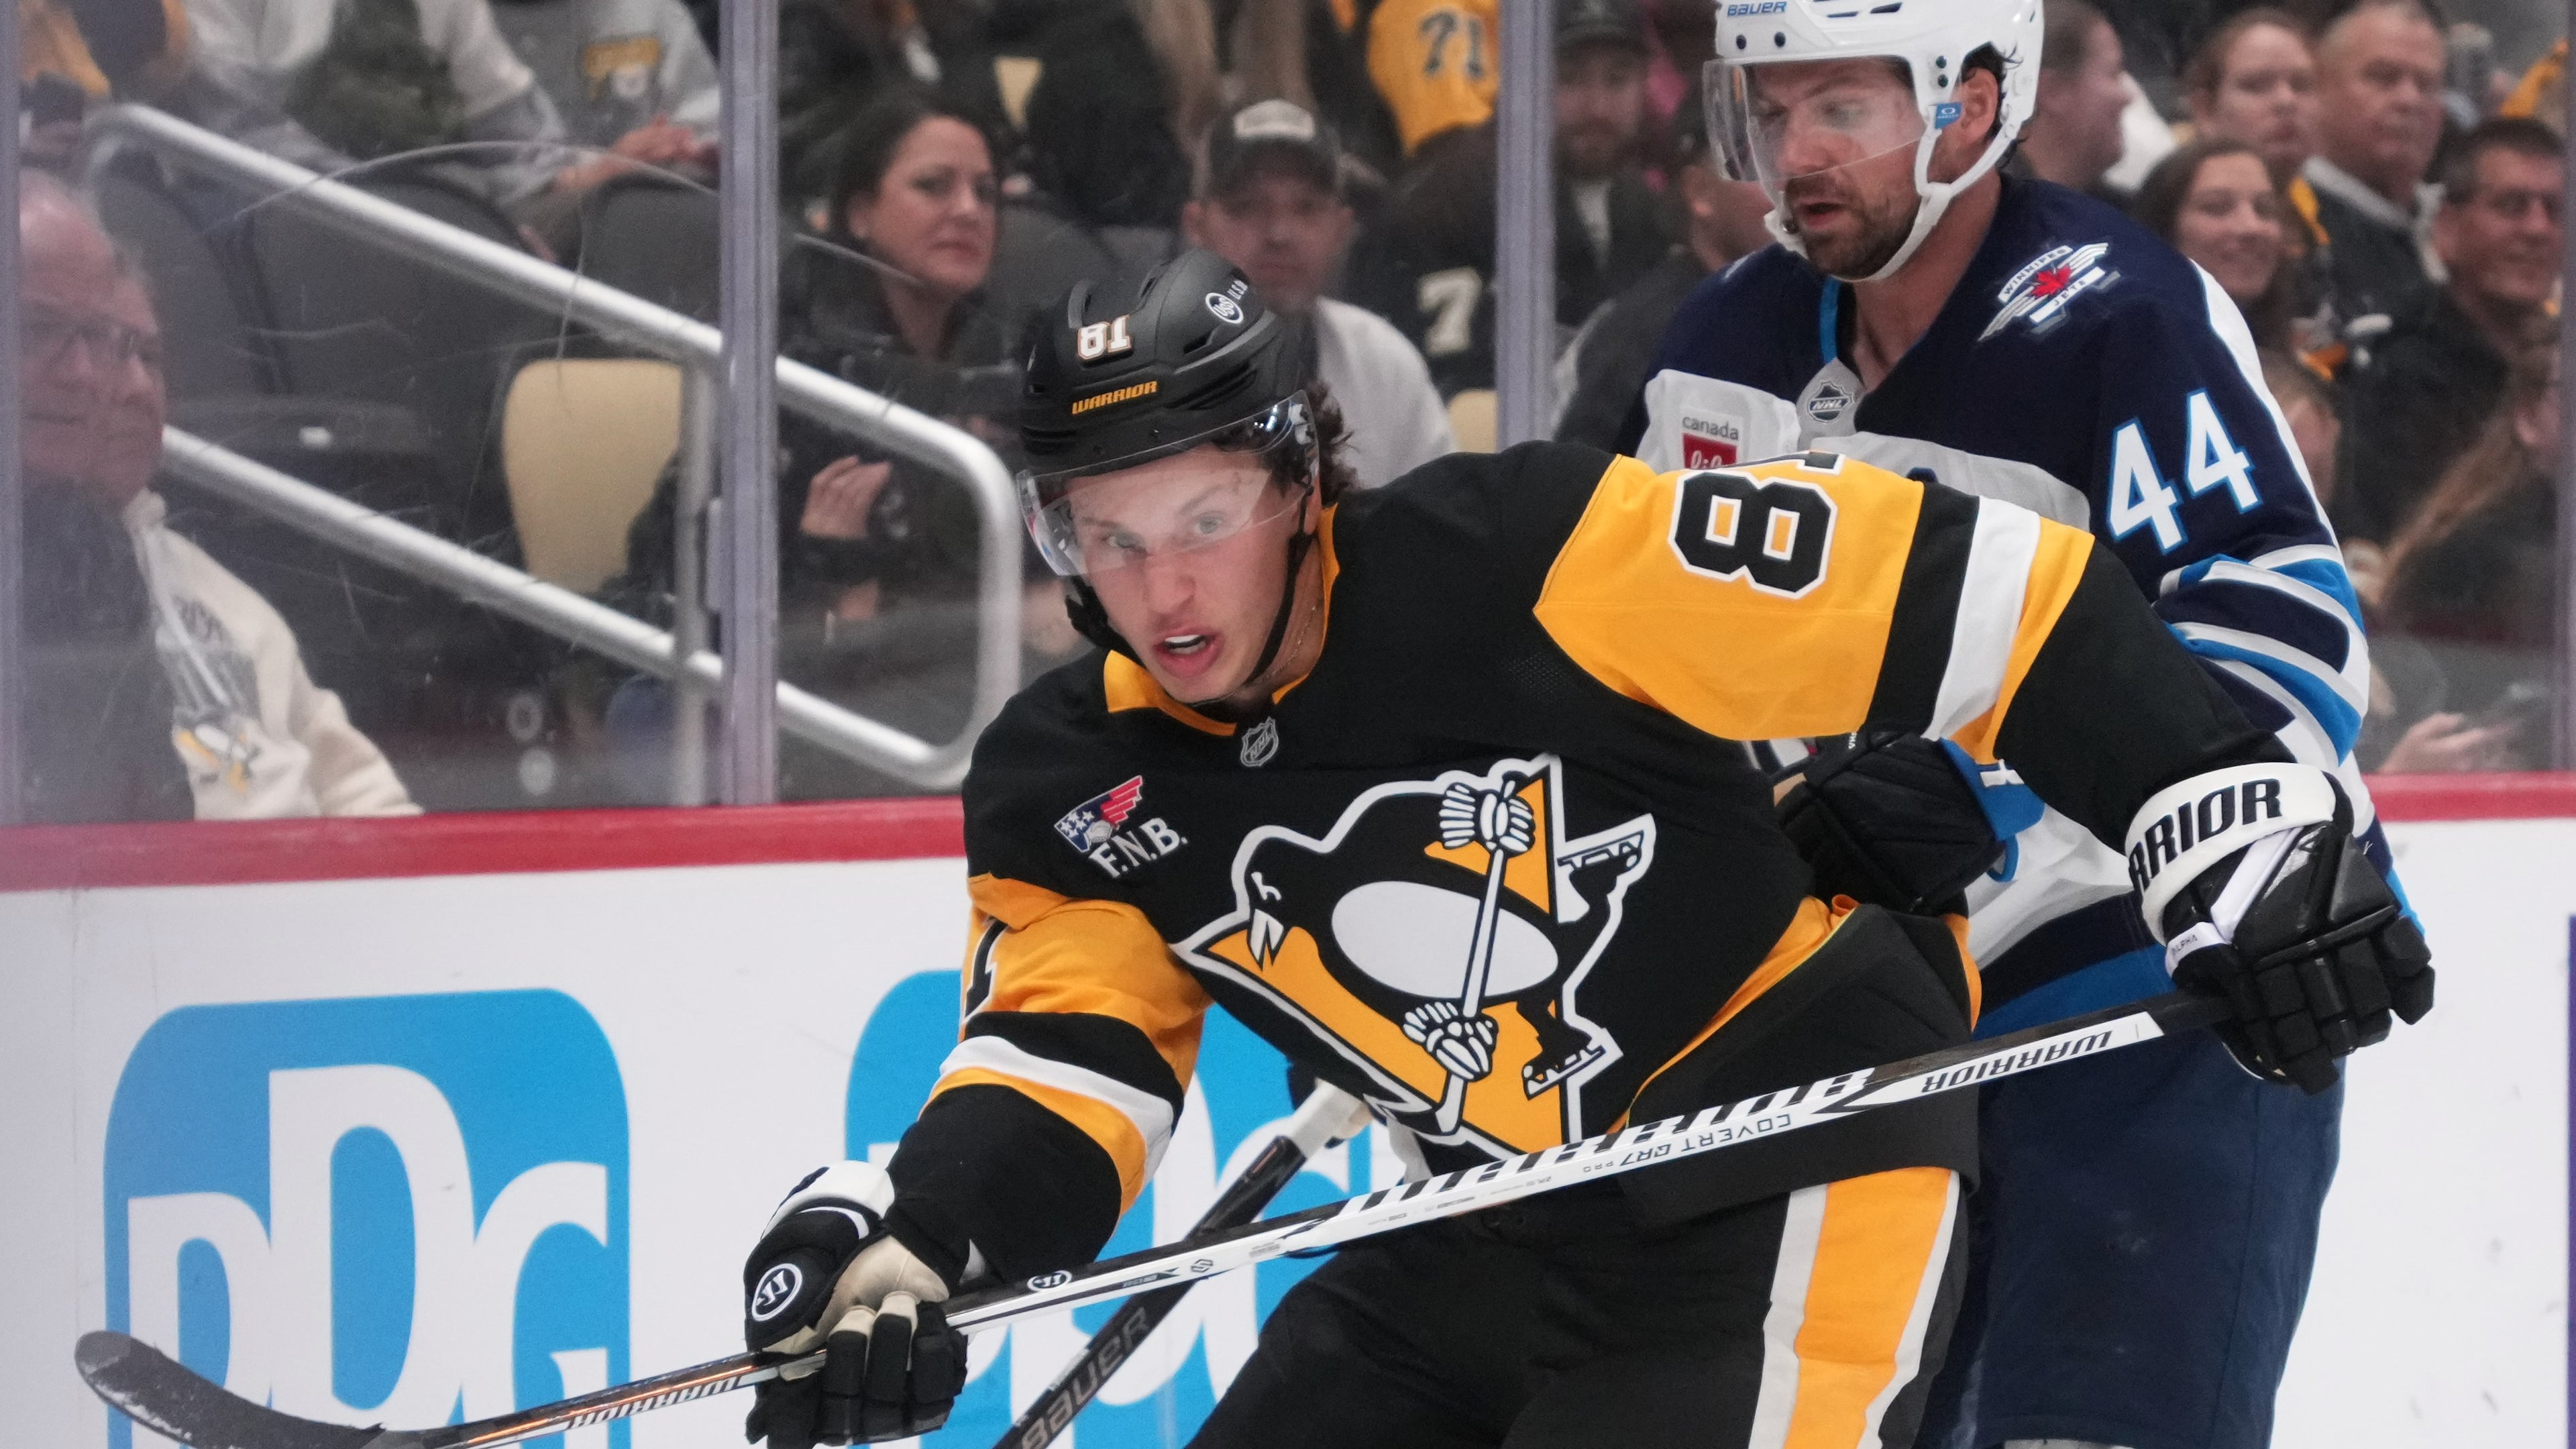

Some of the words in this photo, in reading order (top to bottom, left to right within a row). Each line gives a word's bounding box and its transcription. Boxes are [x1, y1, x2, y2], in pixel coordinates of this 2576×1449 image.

[1417, 10, 1485, 80] 71
[1077, 314, 1134, 360] 81
[1417, 266, 1497, 357] 7
[1071, 380, 1158, 415] WARRIOR
[1682, 415, 1739, 441] canada
[2106, 386, 2263, 555] 44
[1668, 448, 1846, 600] 8
[1088, 817, 1188, 878] F.N.B.
[1920, 1030, 2114, 1093] WARRIOR
[1681, 1113, 1792, 1153] COVERT
[1582, 1160, 1614, 1173] PRO
